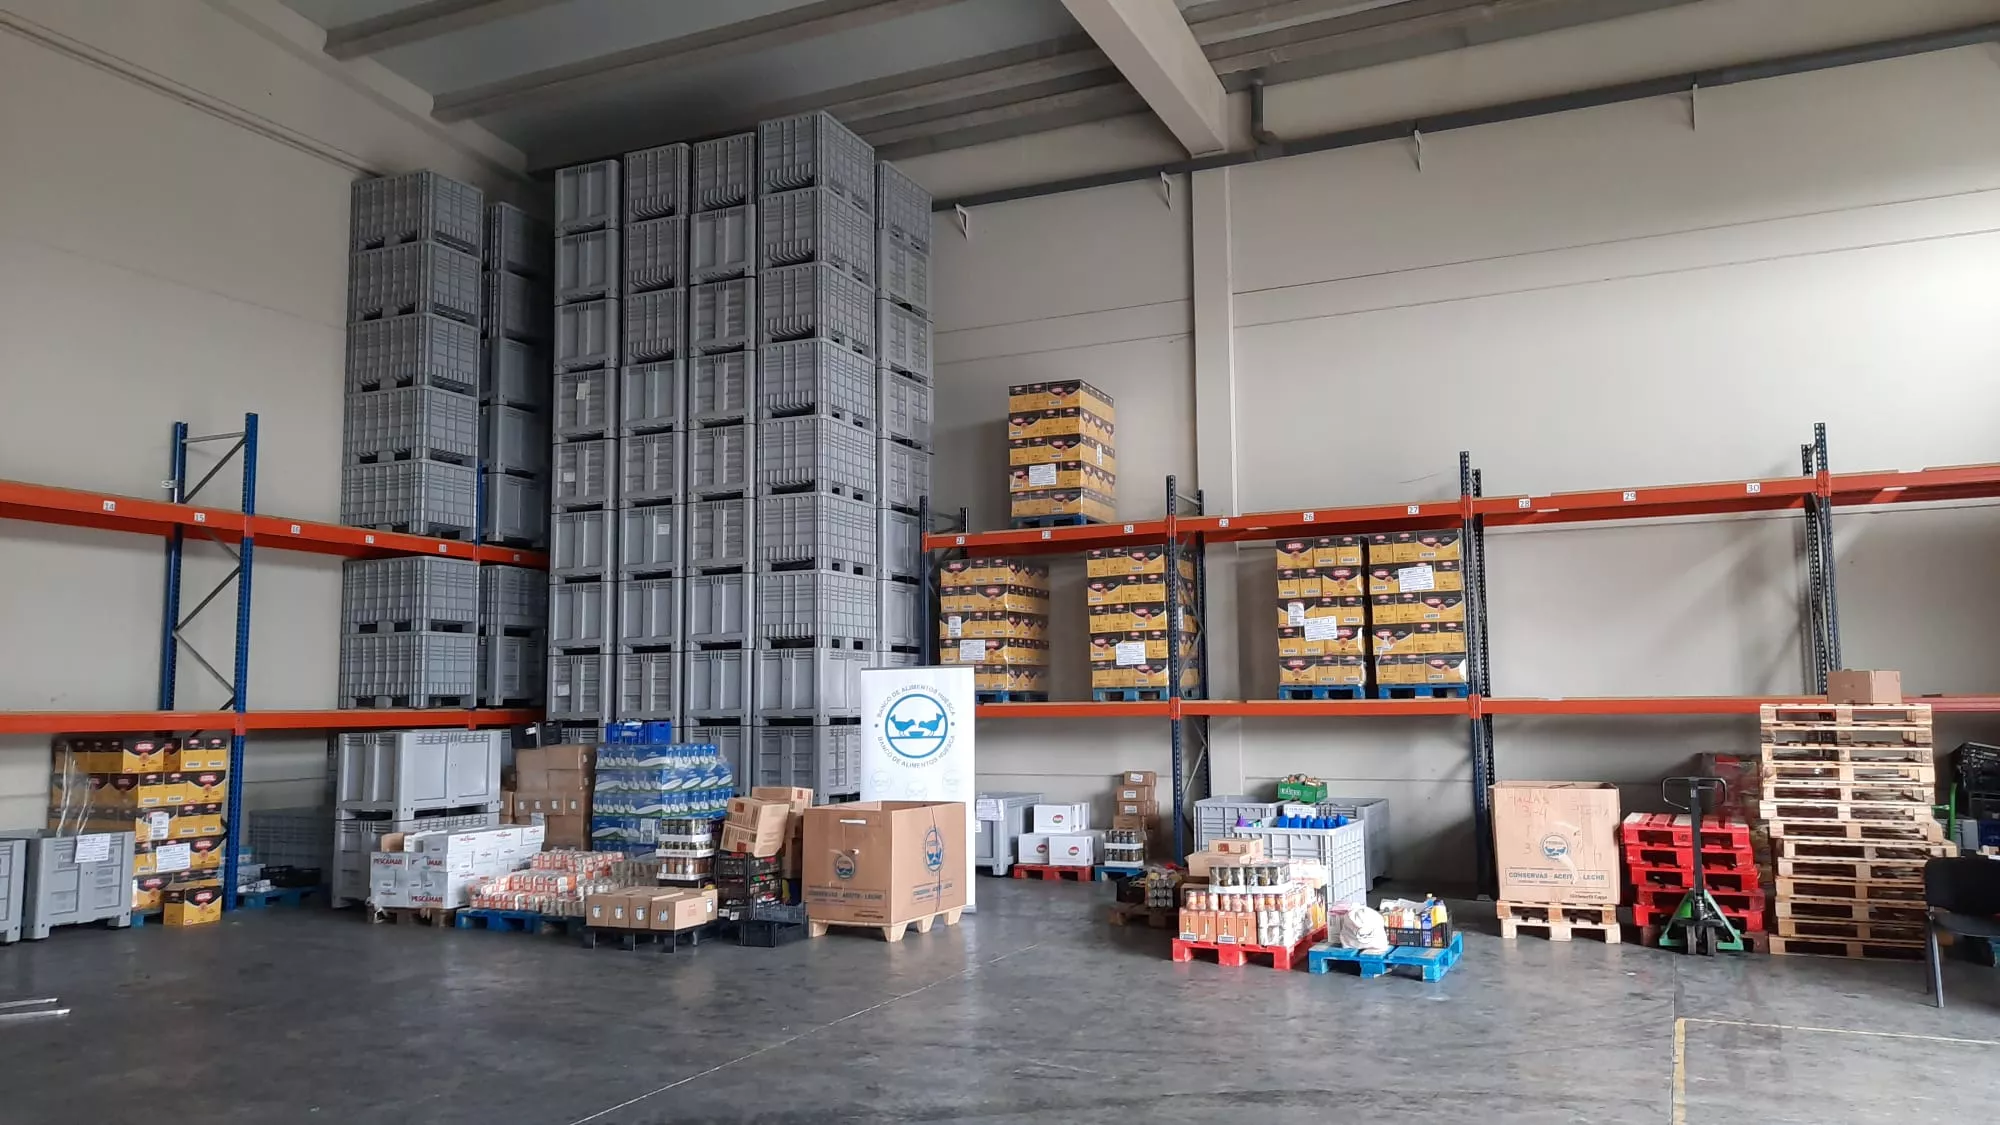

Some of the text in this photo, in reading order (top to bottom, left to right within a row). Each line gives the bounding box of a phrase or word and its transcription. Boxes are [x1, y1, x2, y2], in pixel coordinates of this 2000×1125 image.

[1748, 483, 1760, 492] 30
[1624, 492, 1635, 500] 29
[1519, 499, 1530, 508] 28
[1408, 506, 1419, 514] 27
[1304, 513, 1314, 521] 26
[876, 696, 893, 718] BANCO
[891, 688, 901, 698] DE
[901, 684, 938, 695] ALIMENTOS
[877, 736, 893, 758] BANCO
[891, 756, 901, 766] DE
[901, 757, 938, 769] ALIMENTOS
[373, 858, 403, 866] PESCAMAR
[1583, 873, 1605, 881] LECHE
[411, 895, 443, 904] PESCAMAR
